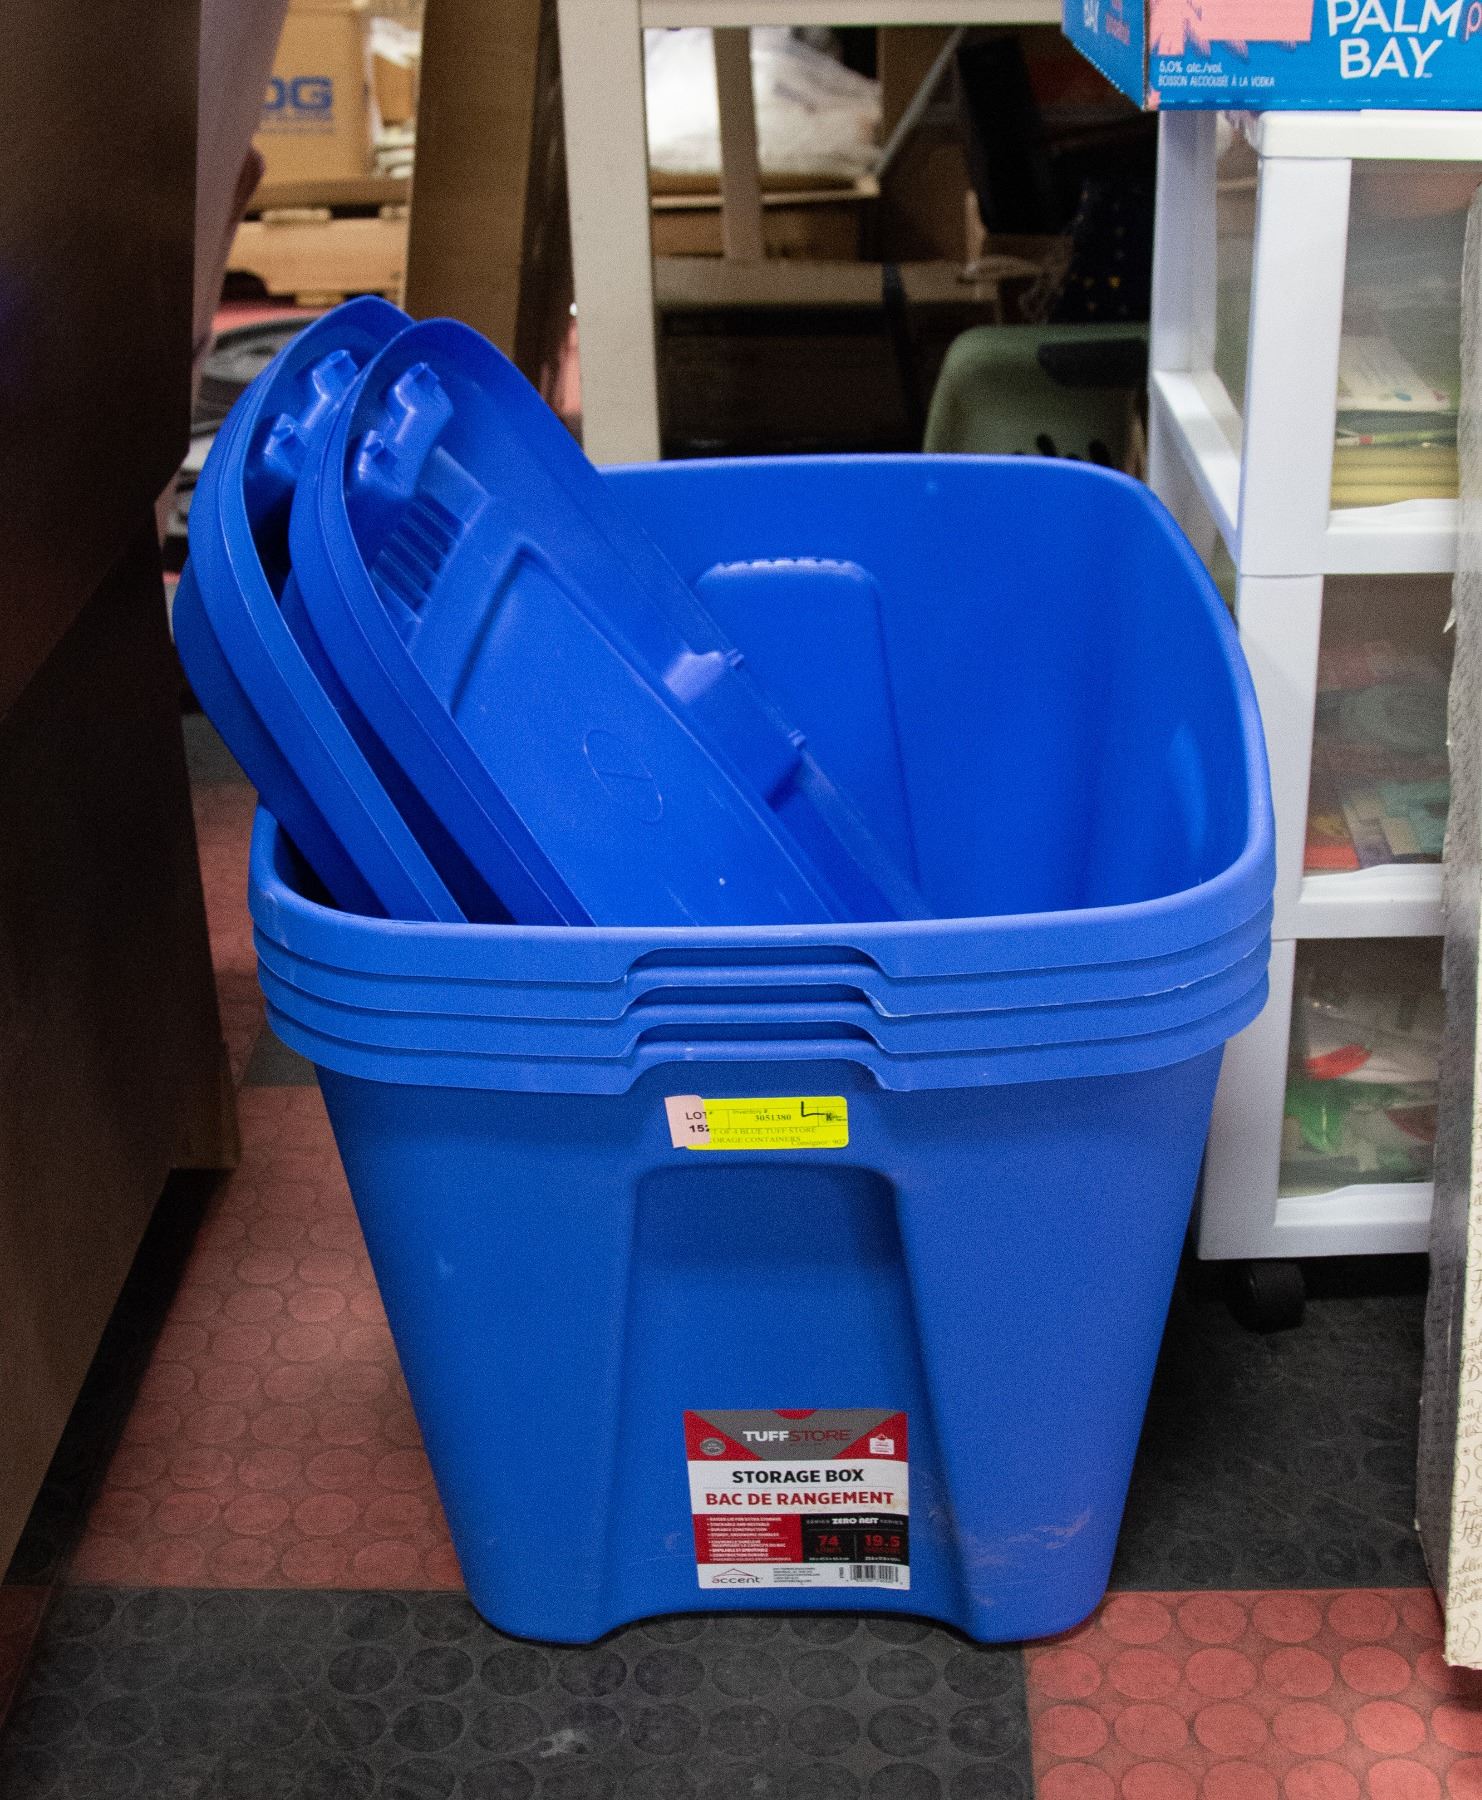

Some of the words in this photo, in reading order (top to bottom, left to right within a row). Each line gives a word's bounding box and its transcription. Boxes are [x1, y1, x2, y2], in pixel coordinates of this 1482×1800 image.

[1327, 0, 1464, 38] PALM
[1339, 36, 1444, 80] BAY
[1158, 61, 1183, 73] 5.0%
[1158, 75, 1187, 87] BOISSON
[1239, 76, 1248, 87] LA
[1251, 76, 1275, 87] VODKA
[732, 1470, 821, 1484] STORAGE
[825, 1468, 864, 1483] BOX
[705, 1493, 742, 1506] BAC
[747, 1493, 773, 1506] DE
[776, 1491, 894, 1506] RANGEMENT
[711, 1575, 760, 1585] accent
